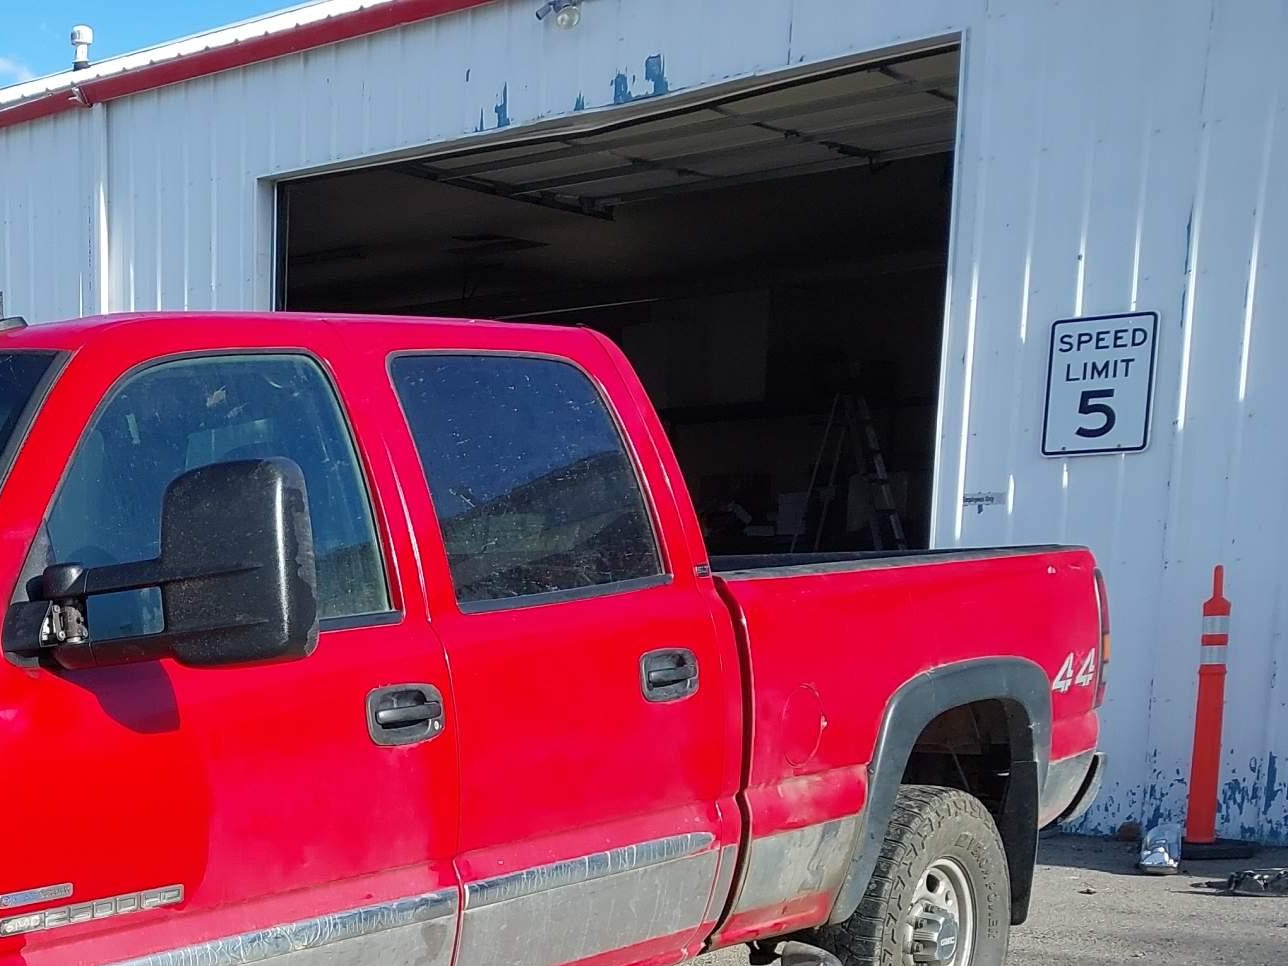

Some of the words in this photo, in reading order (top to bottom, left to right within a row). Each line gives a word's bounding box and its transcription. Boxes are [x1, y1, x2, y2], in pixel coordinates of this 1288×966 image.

[1058, 327, 1148, 353] SPEED
[1064, 358, 1136, 382] LIMIT
[1074, 388, 1116, 439] 5
